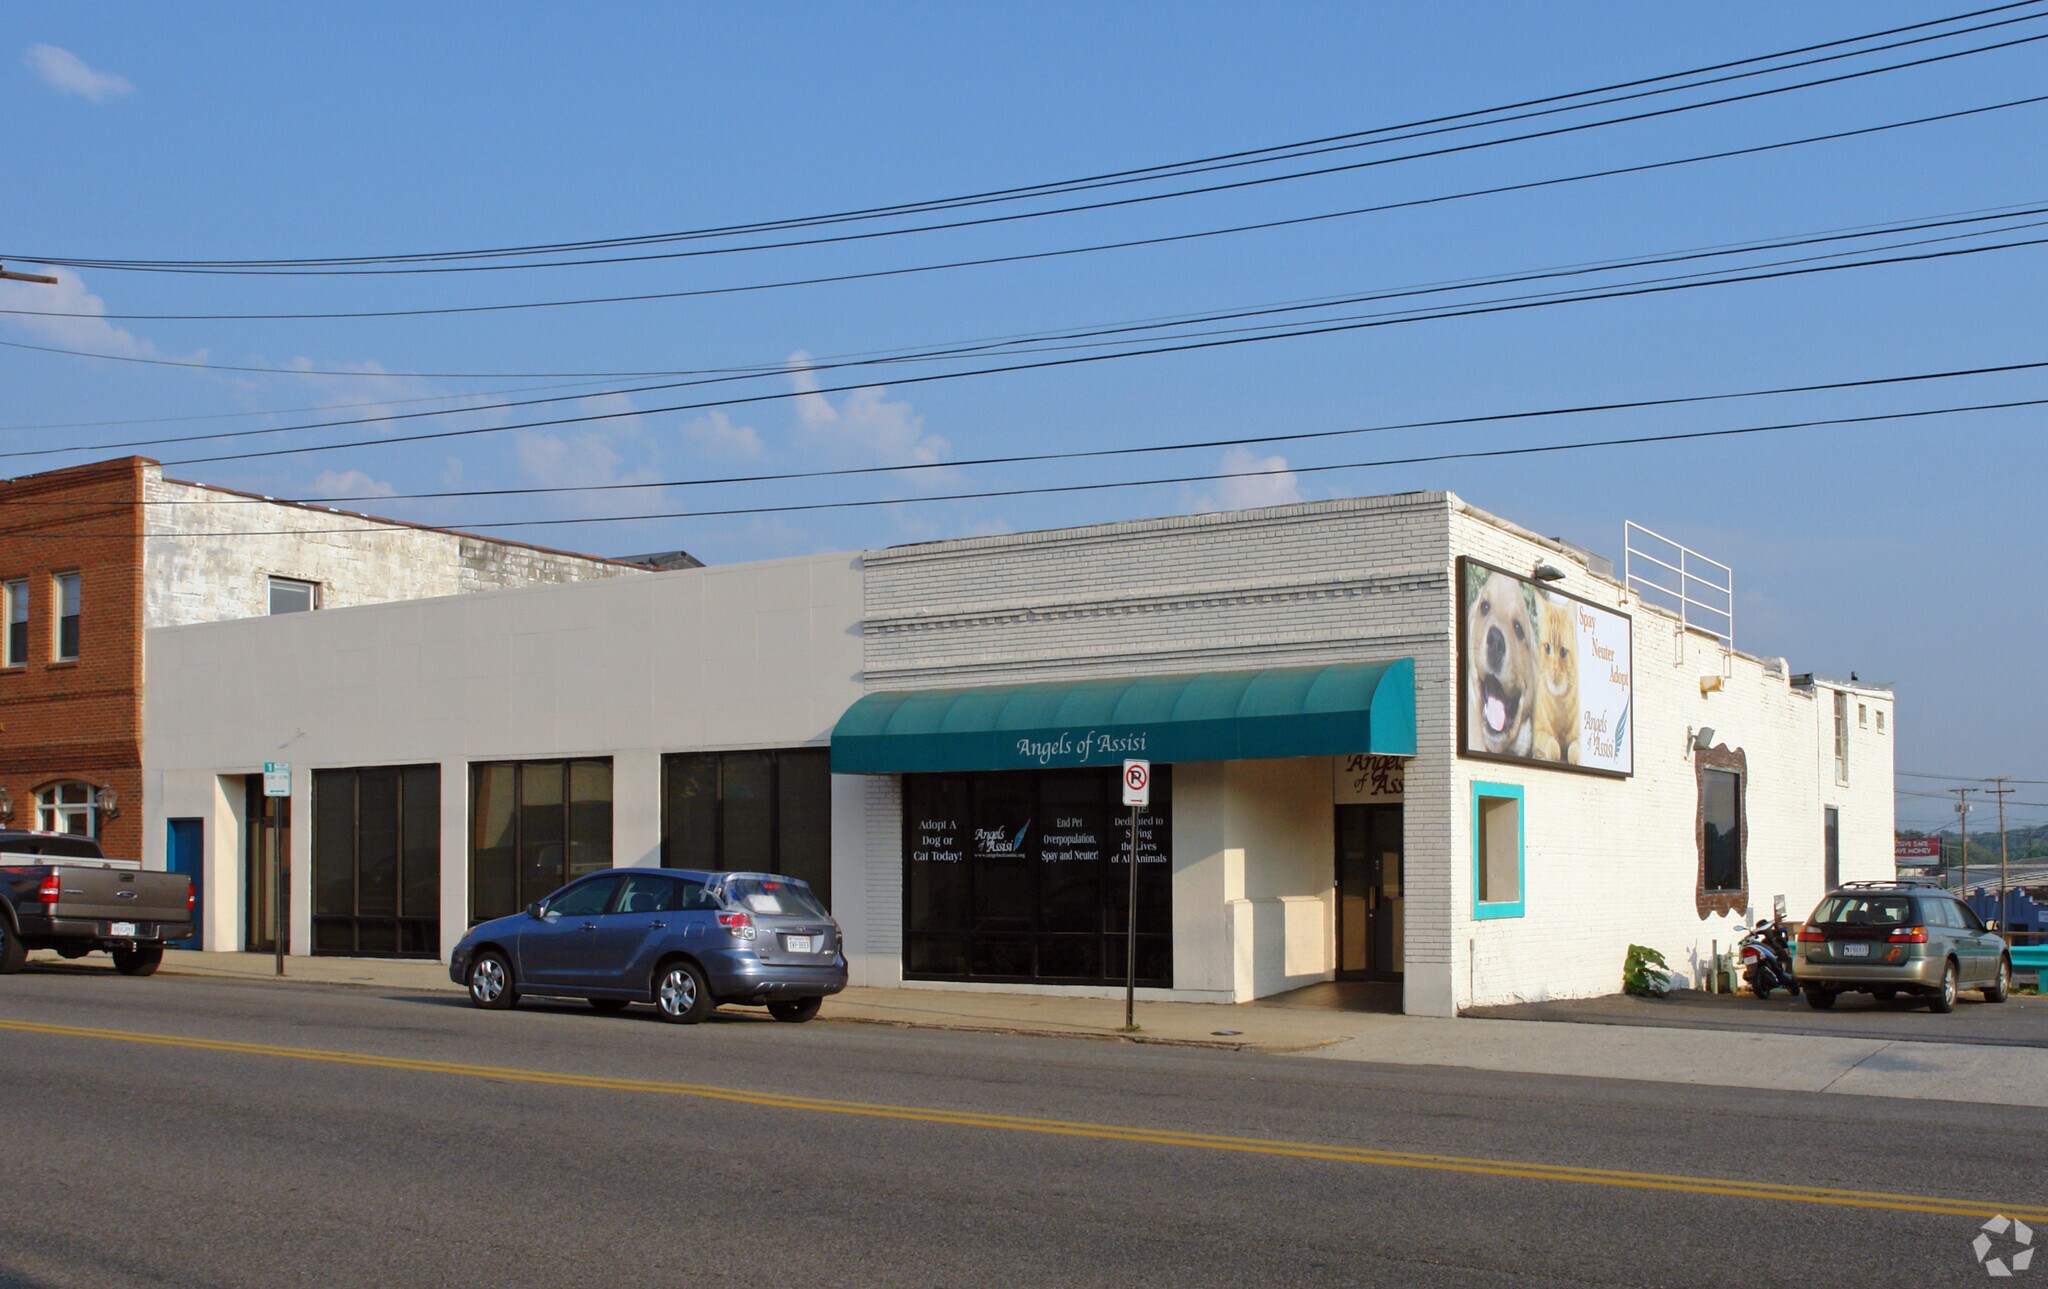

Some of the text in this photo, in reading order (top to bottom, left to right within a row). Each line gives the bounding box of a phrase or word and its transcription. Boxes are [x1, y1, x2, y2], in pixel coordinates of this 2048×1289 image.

[1579, 605, 1596, 635] Spay
[1592, 637, 1615, 662] Neuter
[1609, 664, 1629, 691] Adopt
[1584, 709, 1608, 736] Angels
[1016, 730, 1147, 764] Angels of Assisi
[1592, 734, 1615, 761] Assisi
[1346, 754, 1404, 777] Angel
[1353, 773, 1370, 793] of
[919, 820, 957, 831] Adopt A
[1056, 817, 1083, 828] End Pet
[1114, 817, 1164, 827] Dedited to
[974, 825, 1005, 842] Angels
[1125, 829, 1153, 840] Sing
[922, 836, 953, 847] Dog or
[986, 840, 1013, 853] Assisi
[913, 851, 962, 863] Cat Today!
[1041, 850, 1099, 863] Spay and Neuter!
[1111, 854, 1120, 863] of
